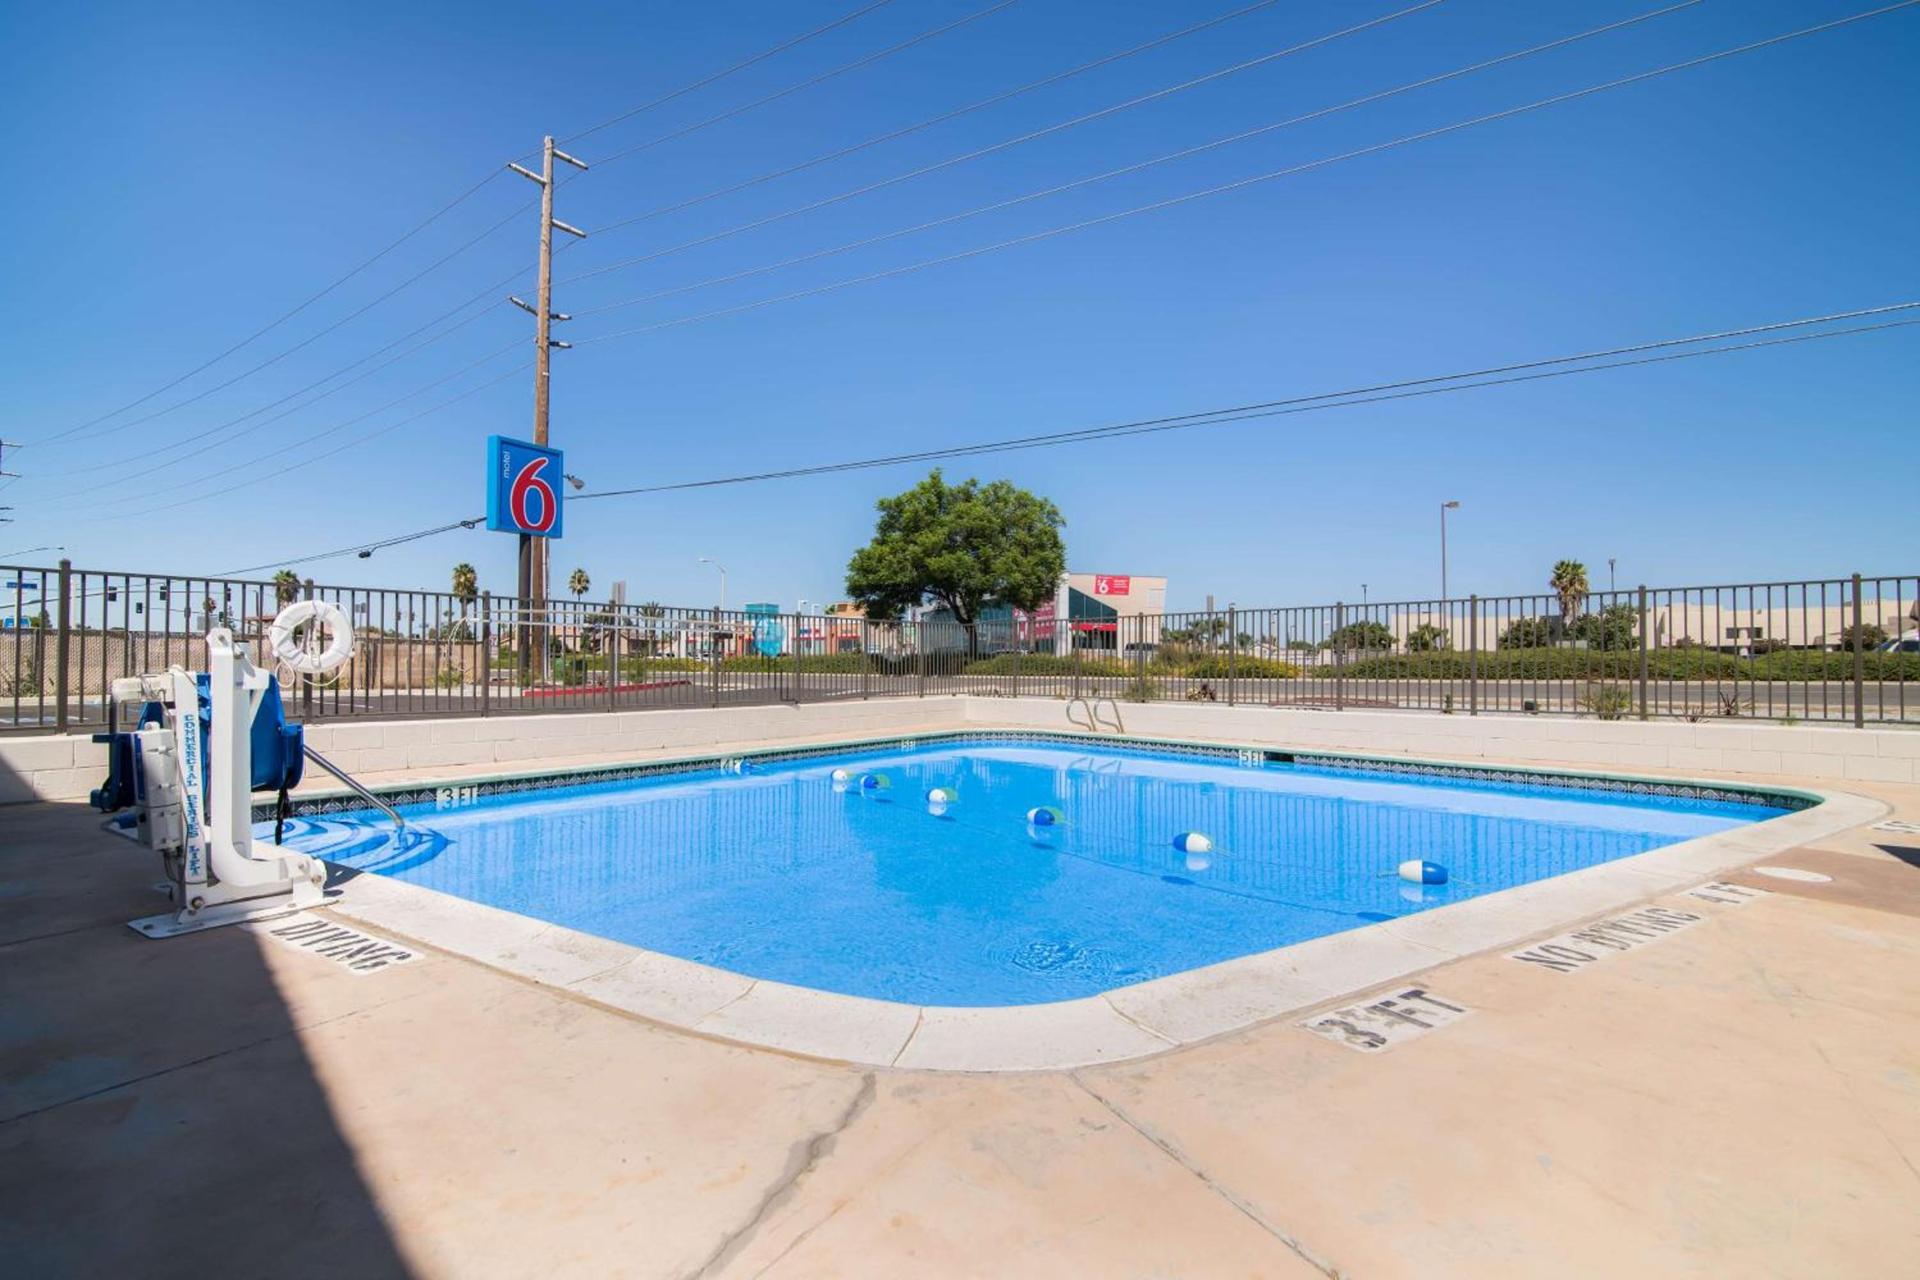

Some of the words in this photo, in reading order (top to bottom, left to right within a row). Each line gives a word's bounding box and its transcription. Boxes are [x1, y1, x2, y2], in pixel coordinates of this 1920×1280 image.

[503, 450, 511, 479] motel
[510, 457, 557, 532] 6
[184, 714, 198, 787] COMMERCIAL
[441, 787, 454, 801] 3
[269, 919, 413, 970] DIVING
[1512, 944, 1598, 973] NO
[1570, 907, 1701, 951] DIVING
